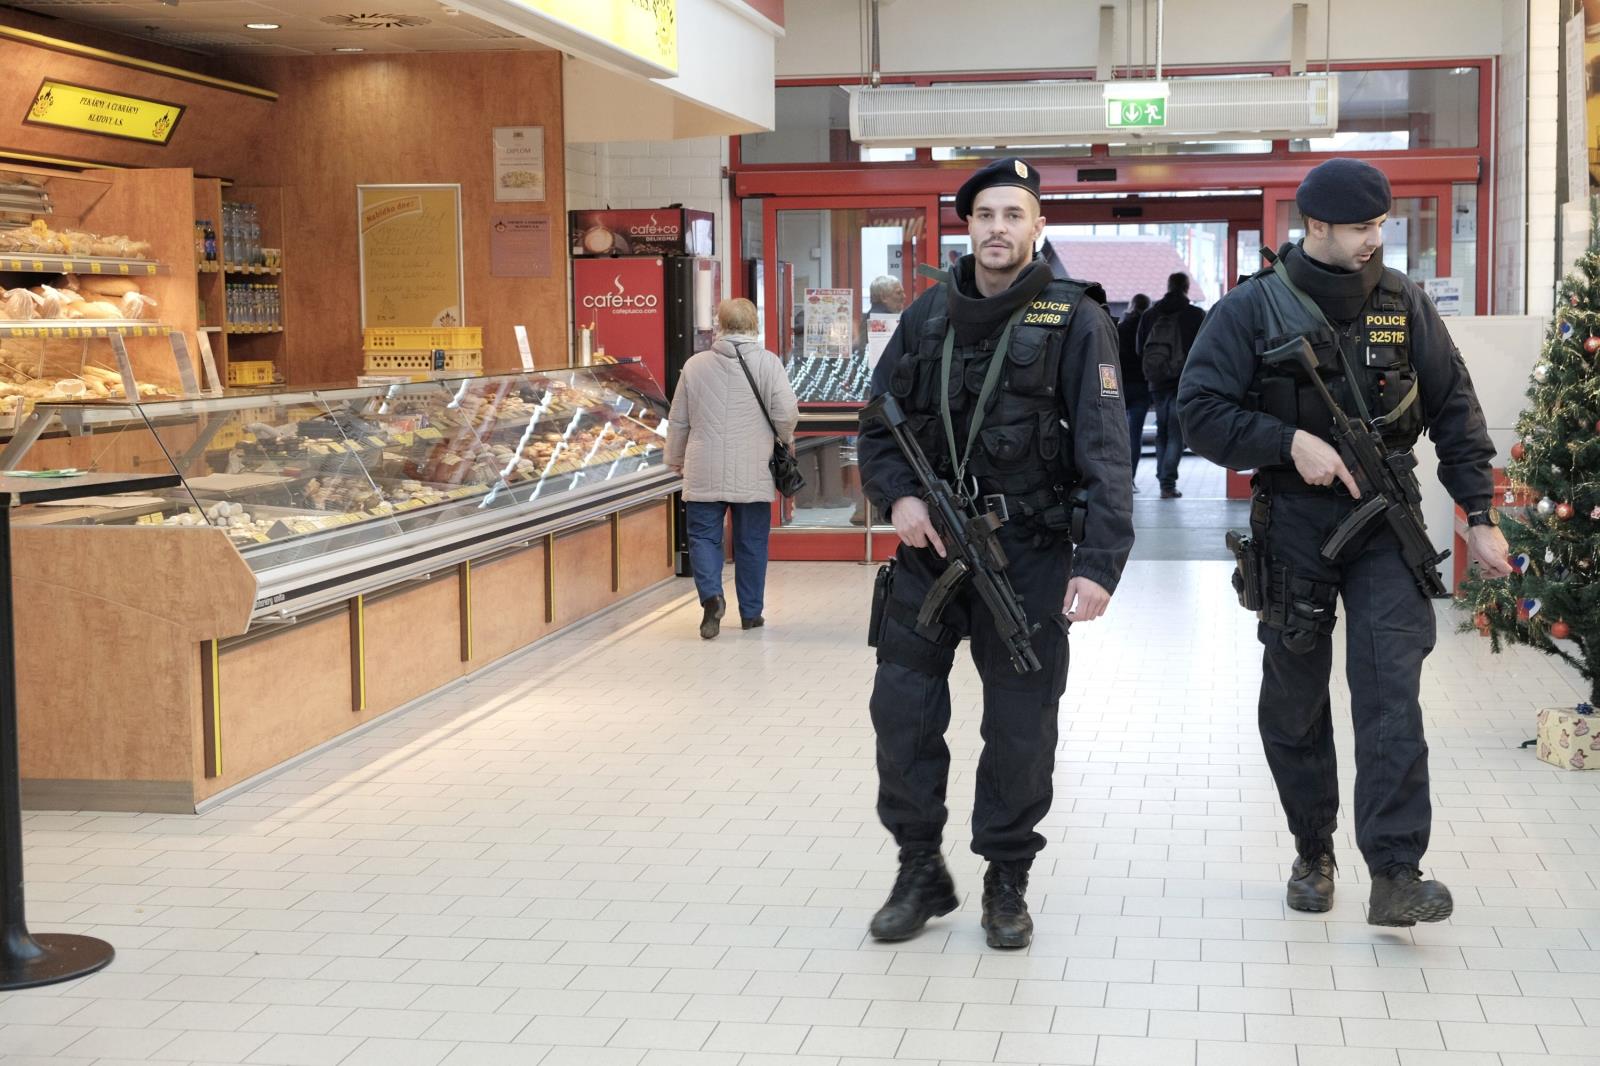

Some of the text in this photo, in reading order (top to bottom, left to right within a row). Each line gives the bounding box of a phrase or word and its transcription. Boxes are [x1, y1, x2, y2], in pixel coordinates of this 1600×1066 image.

[1032, 301, 1070, 312] OLICIE
[1024, 313, 1061, 324] 324169
[1366, 315, 1406, 326] POLICIE
[1369, 331, 1405, 343] 325115
